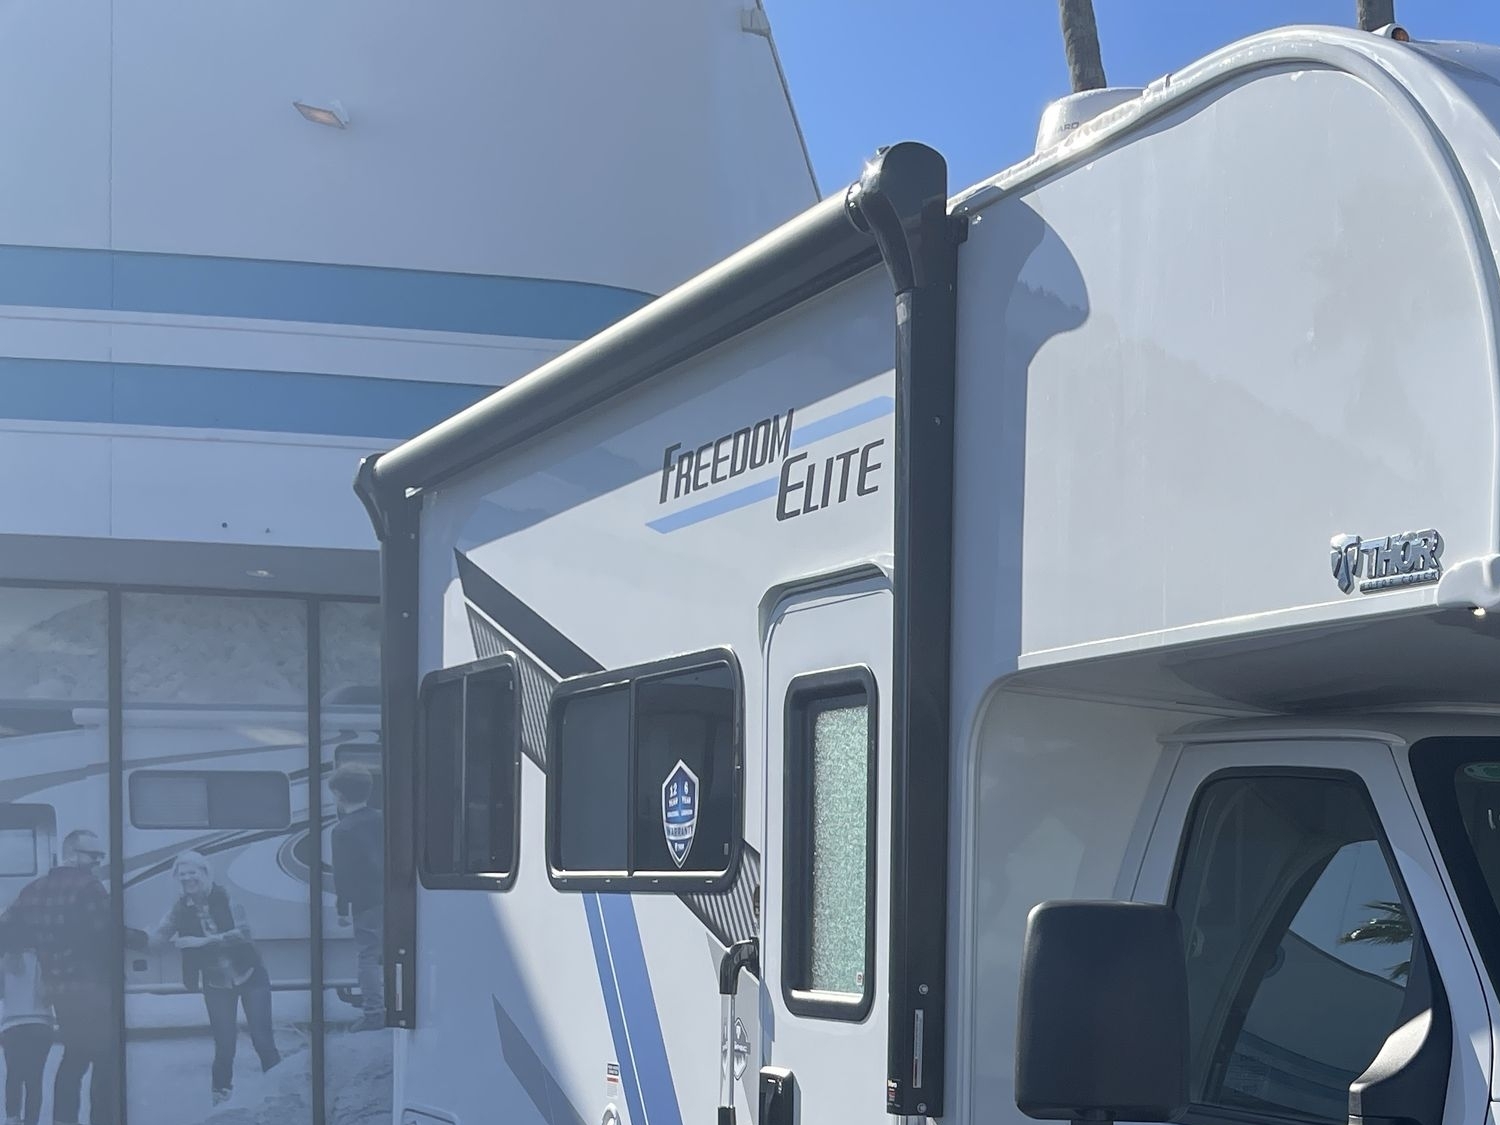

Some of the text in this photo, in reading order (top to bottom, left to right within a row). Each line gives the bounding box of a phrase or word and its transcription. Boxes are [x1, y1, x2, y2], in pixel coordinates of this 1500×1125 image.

[659, 408, 794, 504] FREEDOM
[776, 439, 885, 522] ELITE
[1359, 528, 1442, 579] THOR
